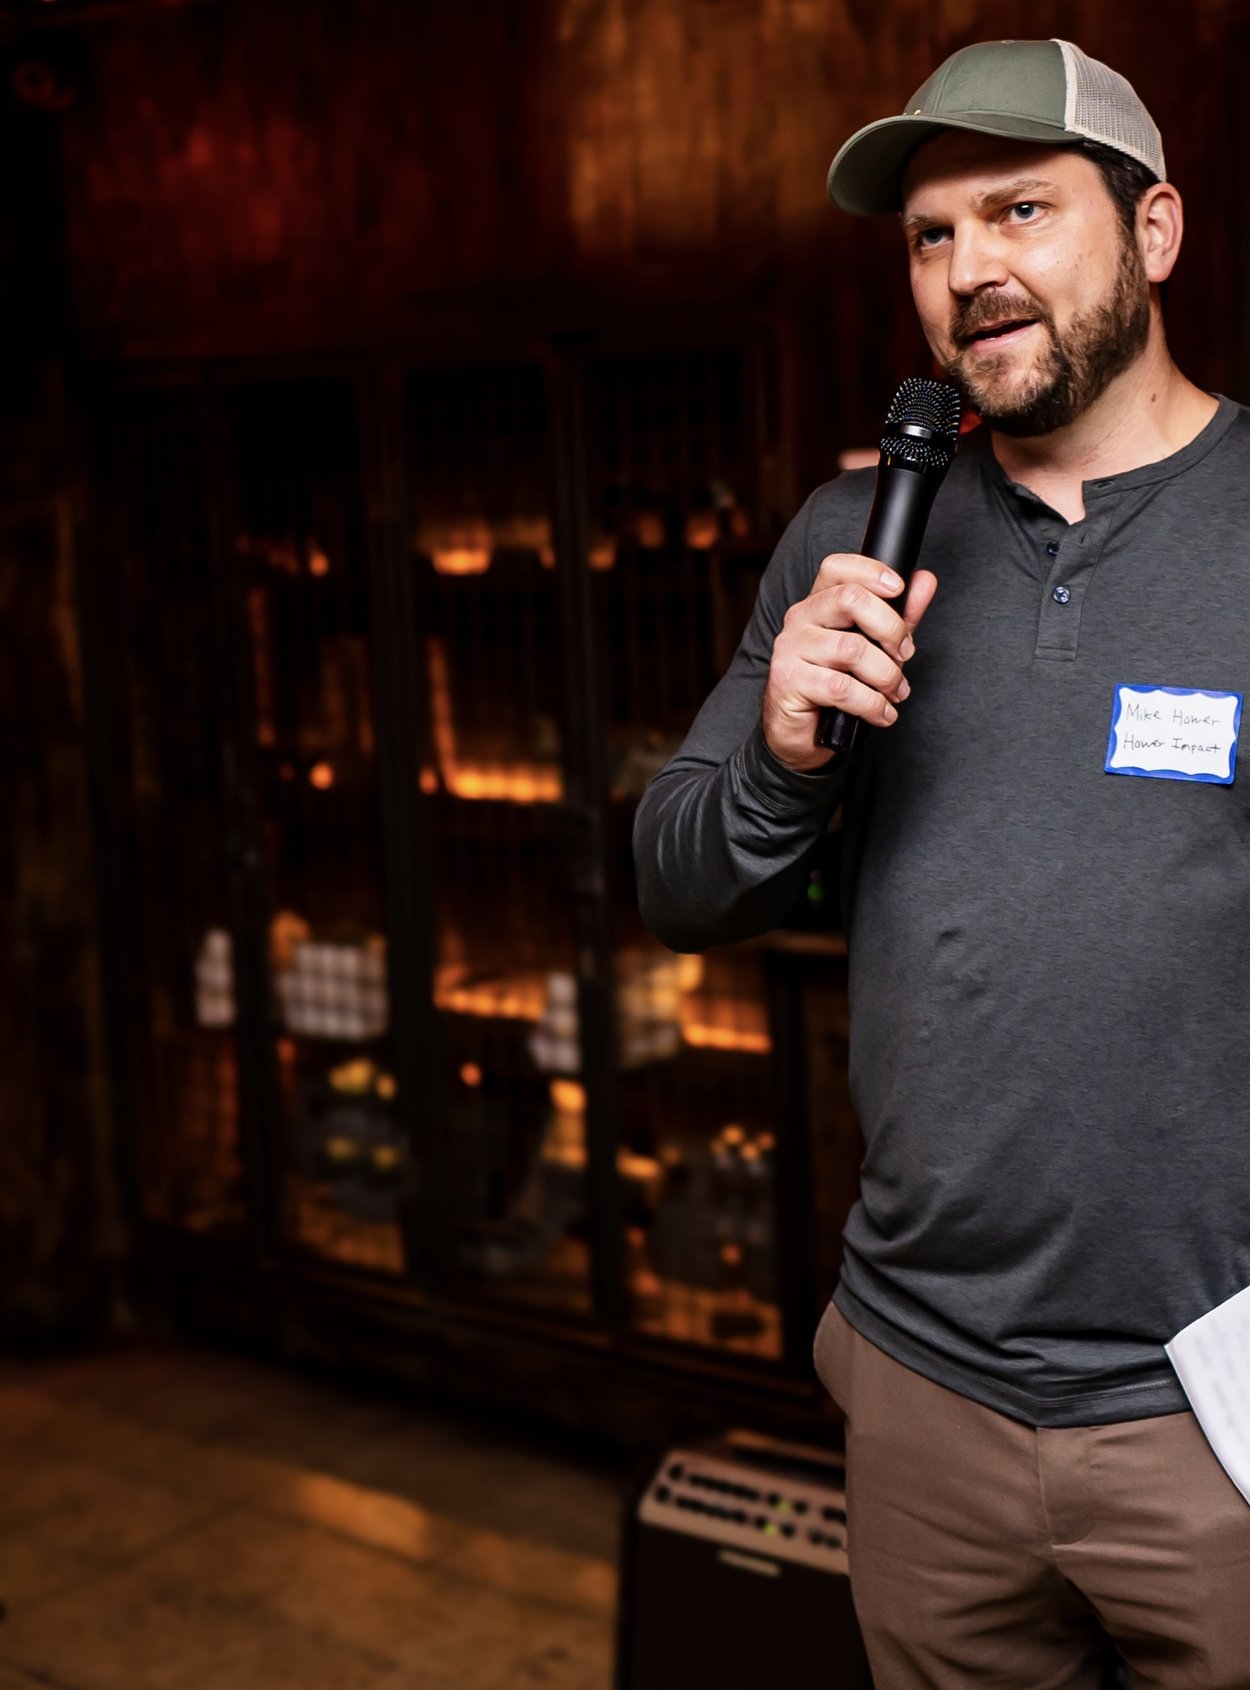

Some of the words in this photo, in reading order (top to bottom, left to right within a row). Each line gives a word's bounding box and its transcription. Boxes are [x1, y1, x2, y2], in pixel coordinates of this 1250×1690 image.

[1126, 703, 1162, 722] Mike
[1172, 708, 1221, 728] Hower
[1122, 732, 1166, 750] Hower
[1170, 737, 1221, 755] Impact
